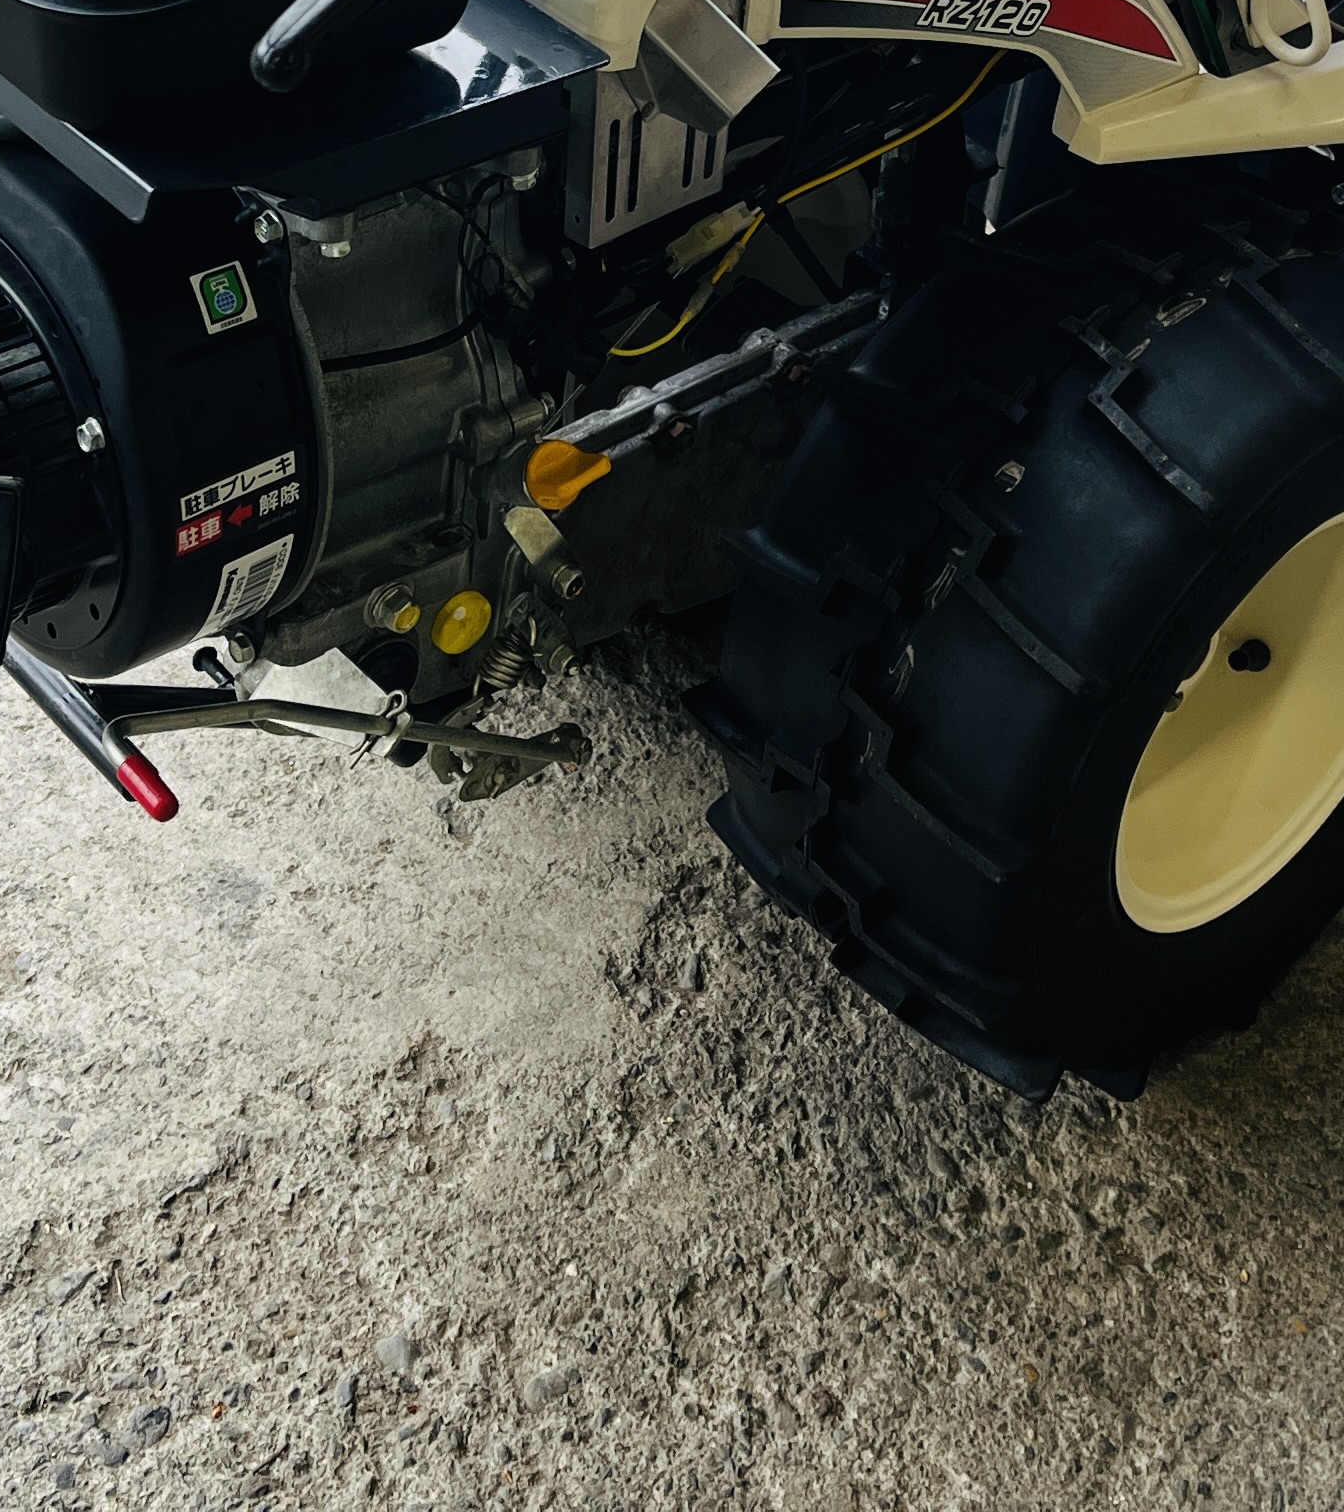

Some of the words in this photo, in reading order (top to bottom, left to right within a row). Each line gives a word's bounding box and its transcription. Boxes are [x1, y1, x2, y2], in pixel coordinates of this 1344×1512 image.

[178, 515, 221, 553] 駐車
[258, 482, 301, 517] 解除
[184, 457, 292, 517] 駐車ブレーキ
